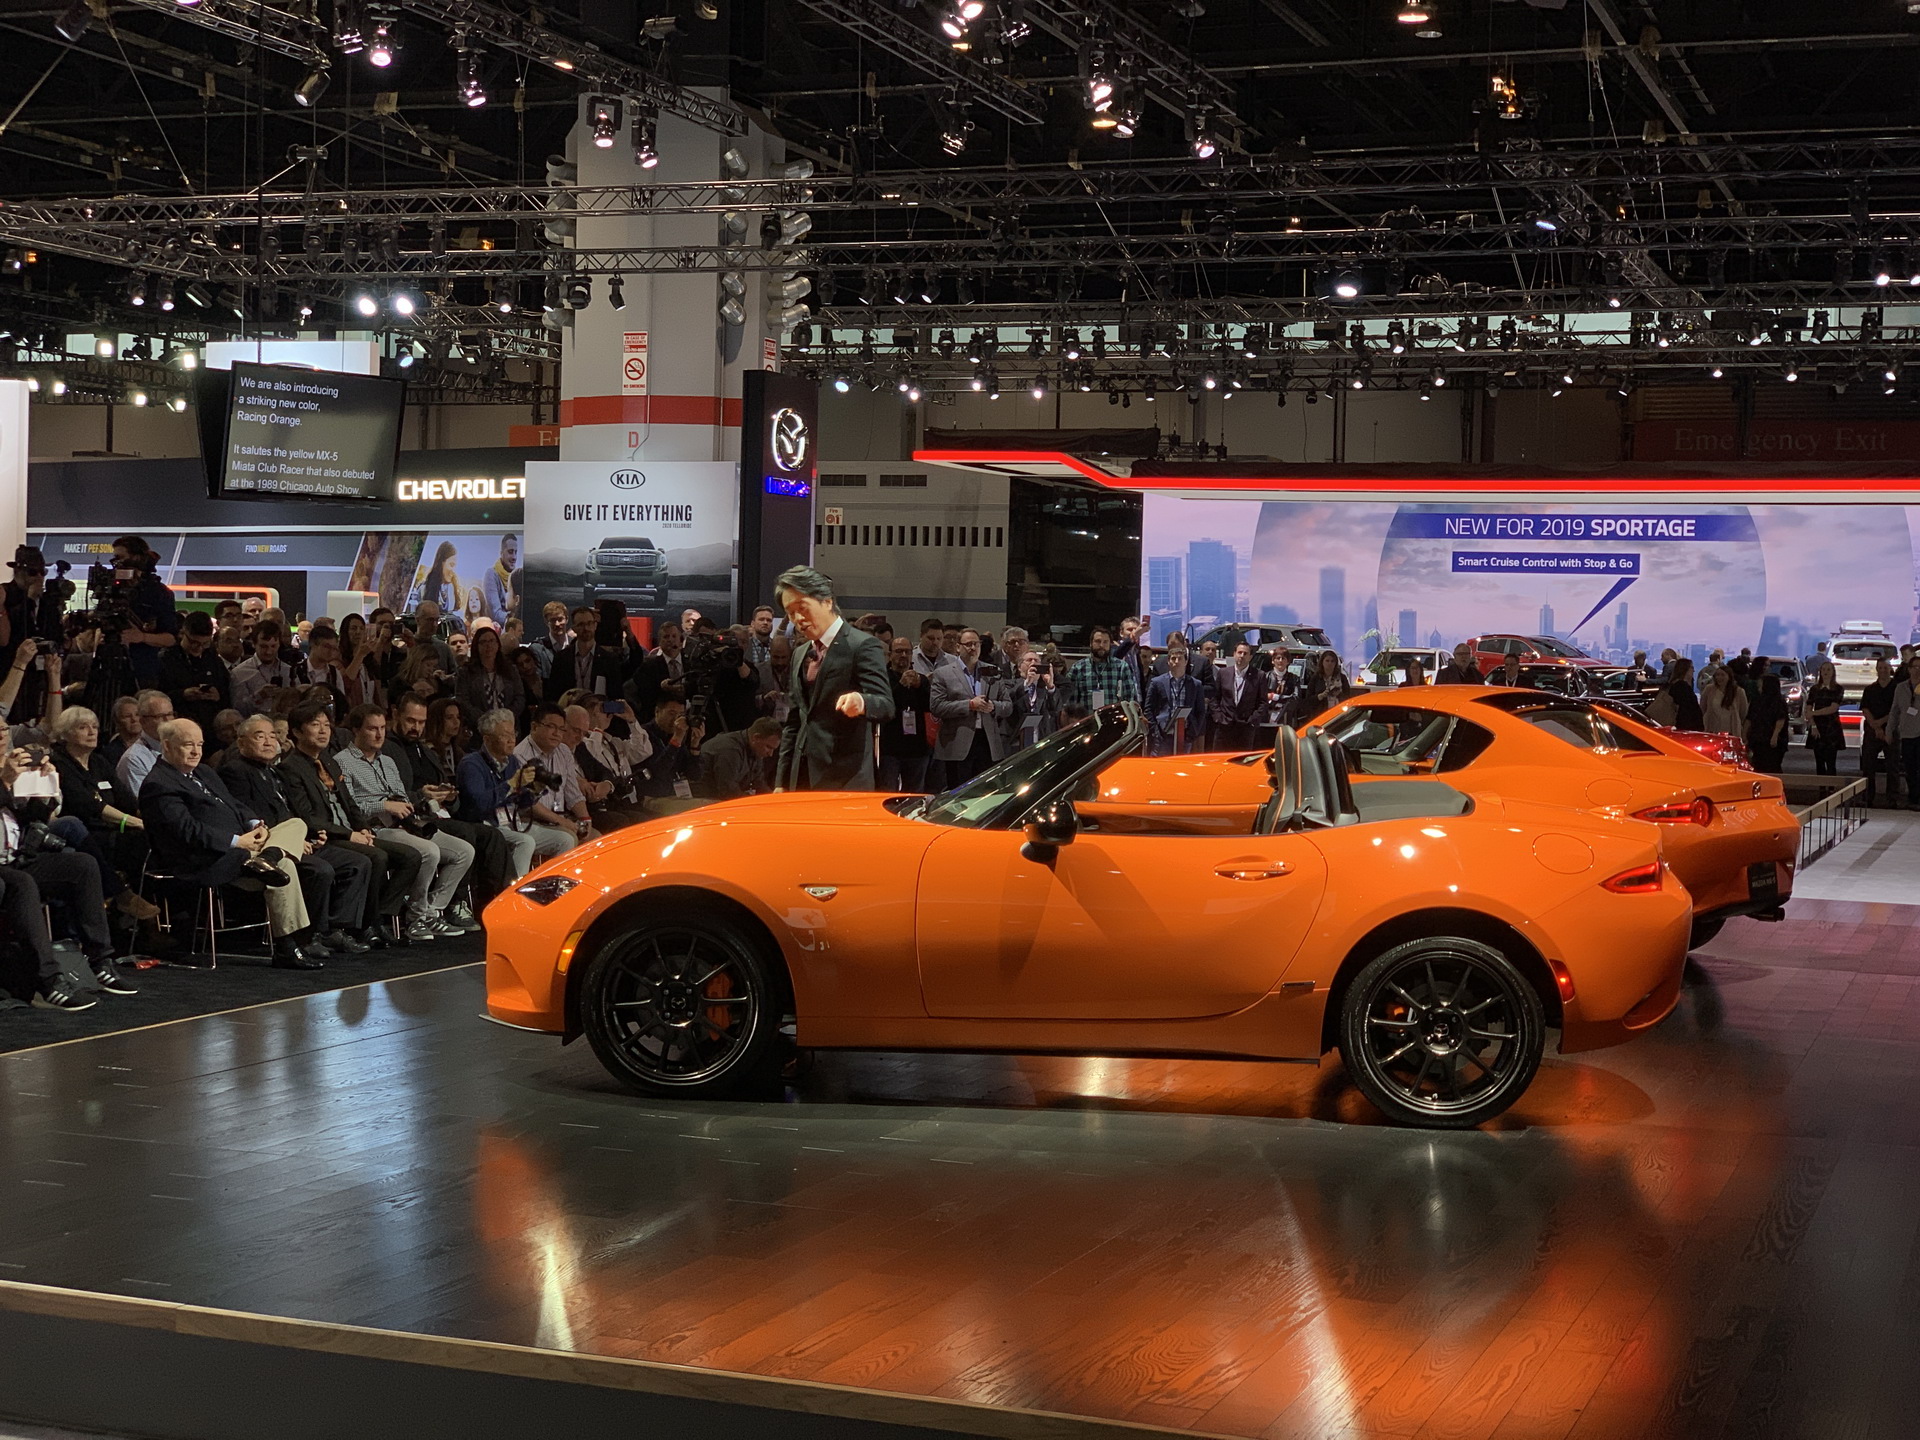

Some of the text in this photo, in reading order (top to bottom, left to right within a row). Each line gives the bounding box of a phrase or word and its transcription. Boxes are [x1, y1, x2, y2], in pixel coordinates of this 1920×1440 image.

[240, 376, 339, 398] We are also introducing
[247, 394, 277, 408] striking
[279, 399, 296, 409] new
[298, 400, 321, 412] color,
[237, 411, 302, 427] Racing Orange.
[628, 431, 639, 448] D
[1673, 427, 1888, 457] Emegency Exit
[233, 444, 339, 461] It salutes the yellow MX-5
[231, 460, 375, 480] Miata Club Racer that also debuted
[230, 478, 361, 495] at the 1989 Chicago Auto Show.
[616, 474, 640, 485] KIA
[398, 477, 526, 501] CHEVROLET
[564, 504, 693, 522] GIVE IT EVERYTHING
[1445, 518, 1696, 537] NEW FOR 2019 SPORTAGE
[63, 543, 81, 554] MAKE
[81, 543, 88, 554] IT
[245, 544, 288, 553] FIND NEW ROADS
[1458, 556, 1633, 570] Smart Cruise Control with Stop & Go
